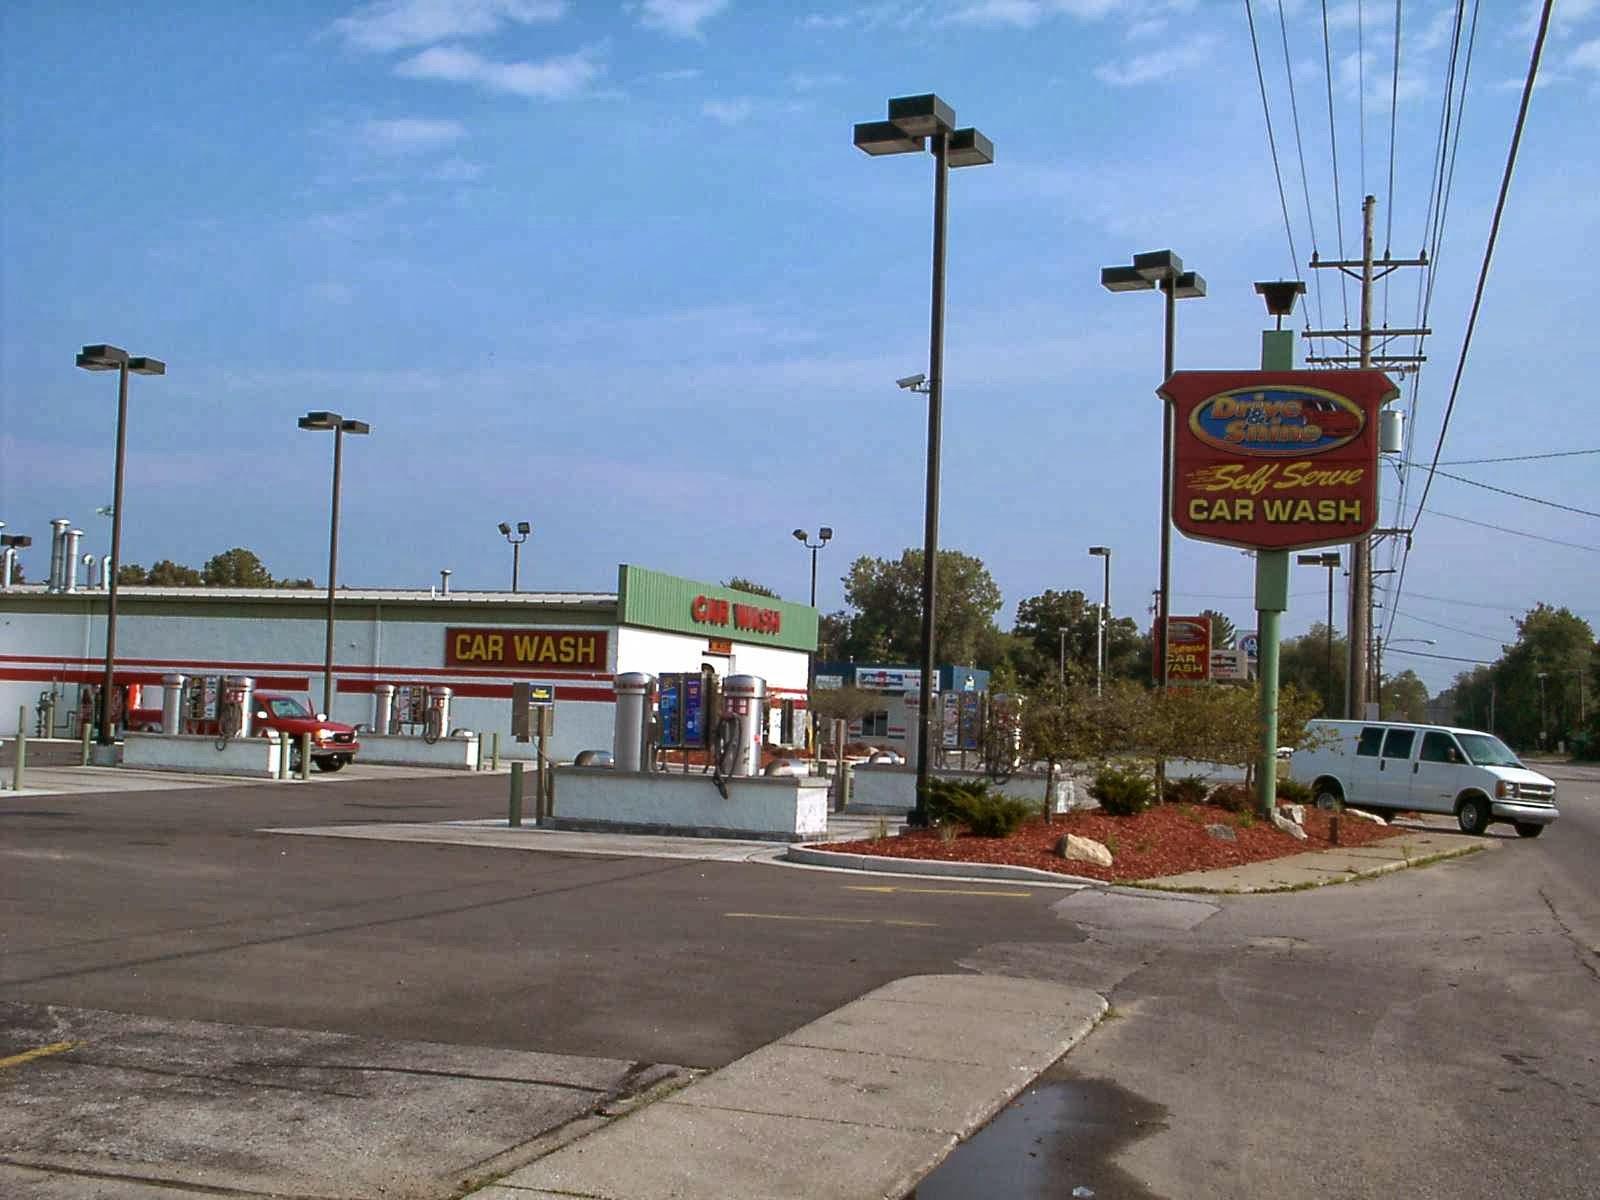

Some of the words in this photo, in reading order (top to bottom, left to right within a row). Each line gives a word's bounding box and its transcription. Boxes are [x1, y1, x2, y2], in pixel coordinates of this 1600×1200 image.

[1205, 463, 1280, 496] Self
[1273, 461, 1364, 489] Serve
[1189, 499, 1254, 521] CAR
[1263, 499, 1361, 521] WASH
[455, 634, 504, 661] CAR
[513, 635, 596, 663] WASH
